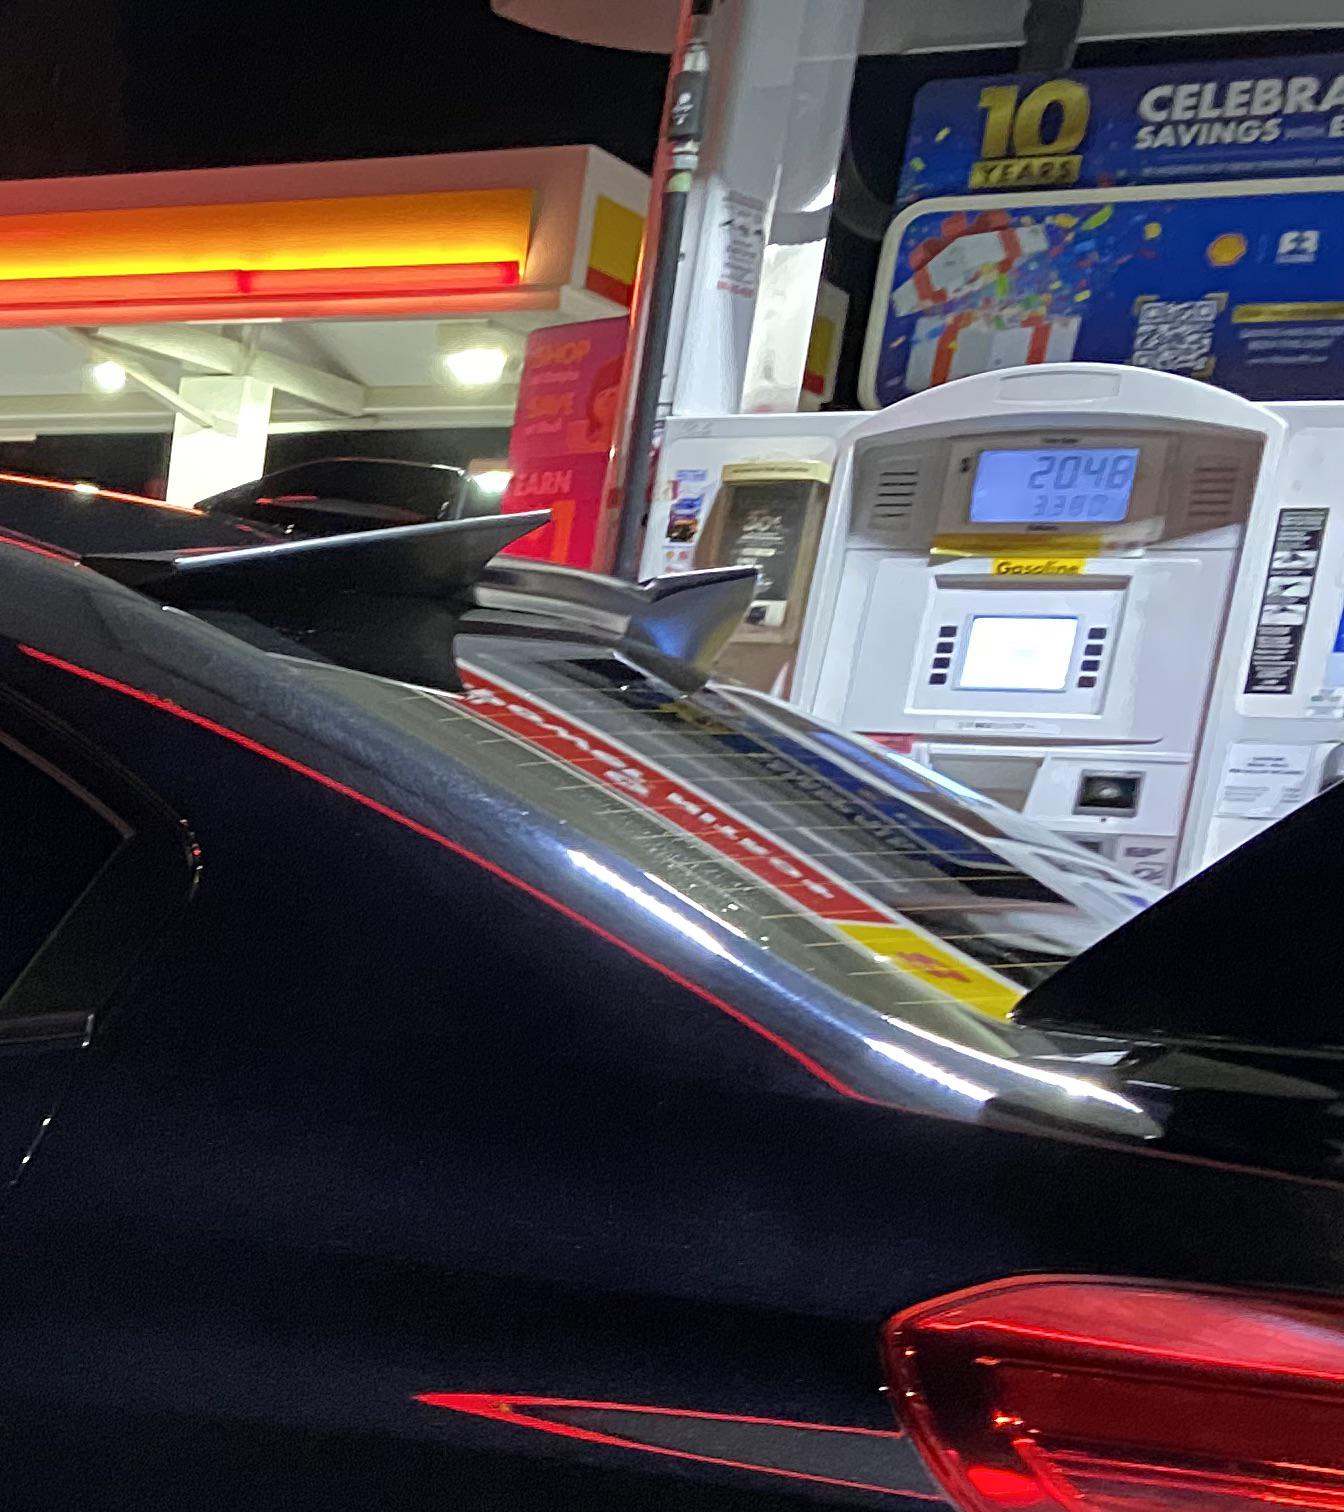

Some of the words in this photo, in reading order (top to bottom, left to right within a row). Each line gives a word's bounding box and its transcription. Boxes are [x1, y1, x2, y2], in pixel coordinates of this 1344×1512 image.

[1138, 74, 1344, 122] CELEBRA
[978, 79, 1090, 158] 10
[1135, 118, 1283, 149] SAVINGS
[981, 160, 1074, 183] YEARS
[514, 470, 574, 496] EARN
[996, 560, 1081, 576] Gasoline
